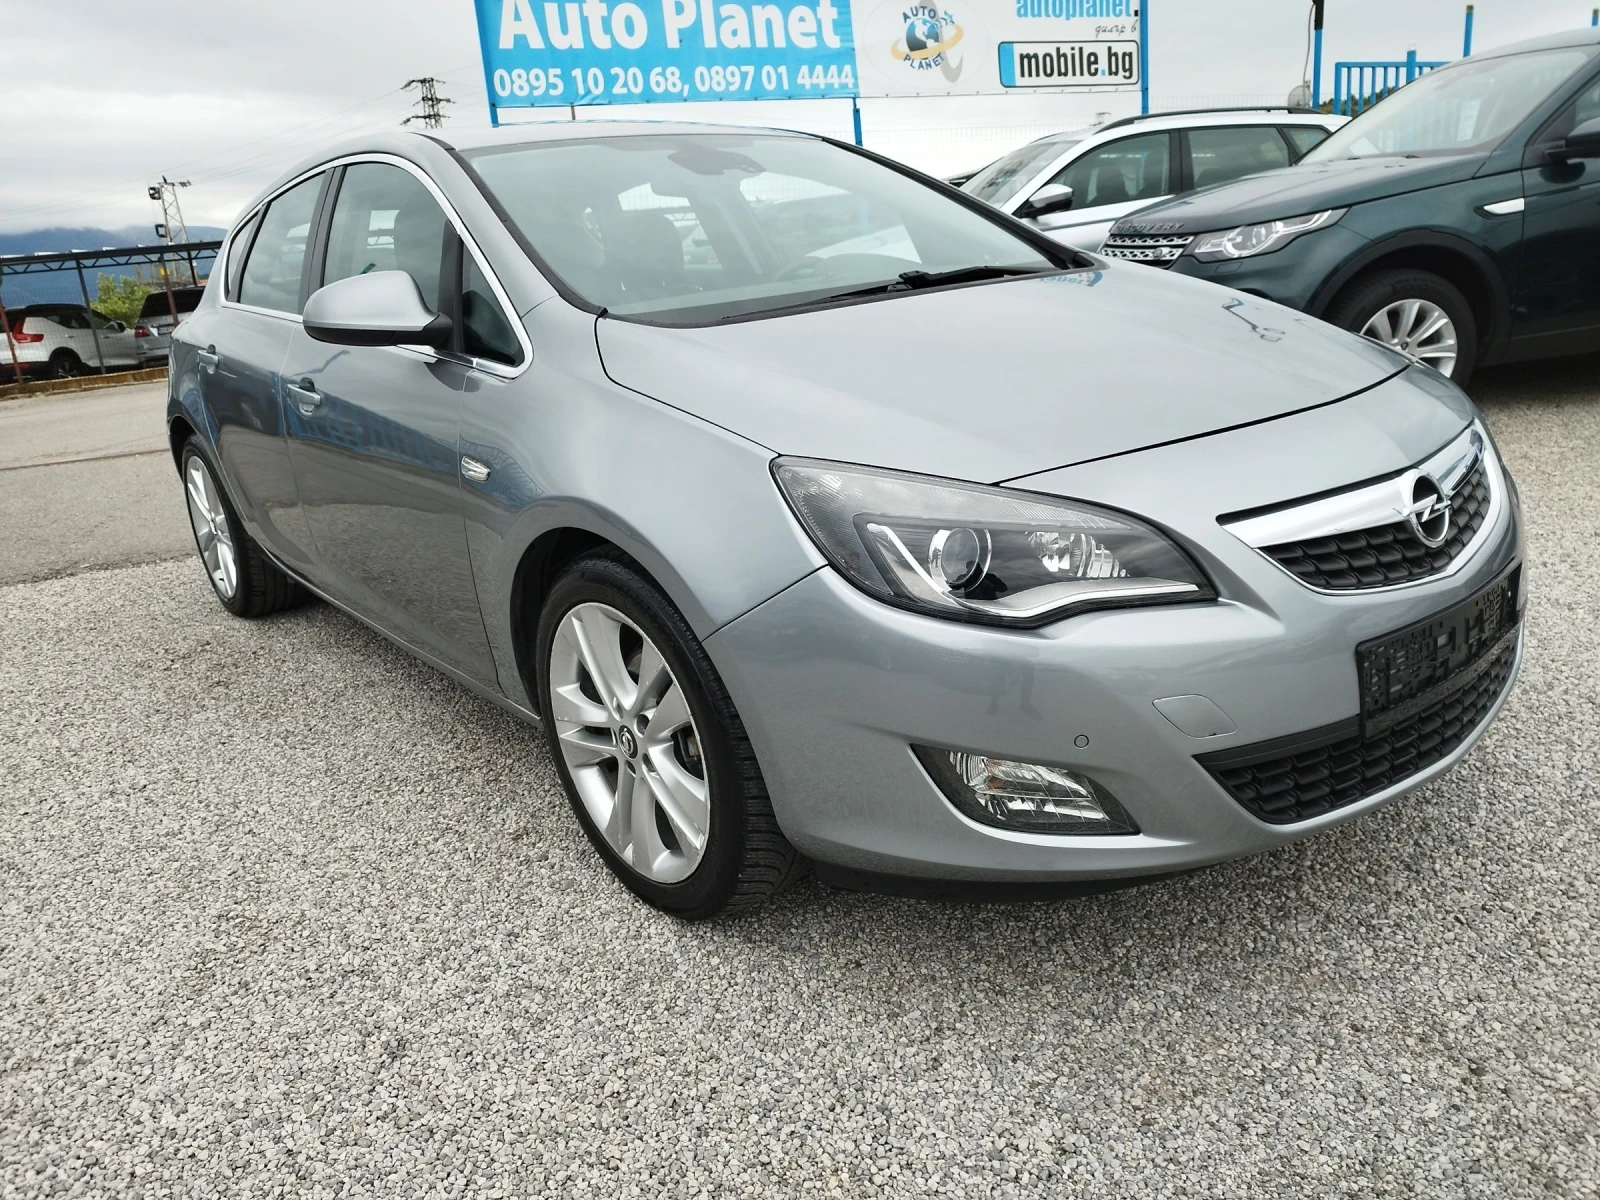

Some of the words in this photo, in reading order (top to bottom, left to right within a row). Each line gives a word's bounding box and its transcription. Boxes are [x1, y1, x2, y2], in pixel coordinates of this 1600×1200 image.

[499, 0, 648, 50] Auto
[662, 0, 841, 49] Planet
[902, 5, 937, 24] AUTO
[903, 52, 944, 70] PLANET
[1019, 46, 1133, 80] mobile.bg
[493, 67, 564, 97] 0895
[571, 67, 605, 95] 10
[610, 66, 644, 94] 20
[649, 66, 690, 97] 68,
[694, 65, 755, 92] 0897
[761, 65, 789, 91] 01
[797, 64, 855, 90] 4444
[1116, 222, 1185, 233] DISCOVERY
